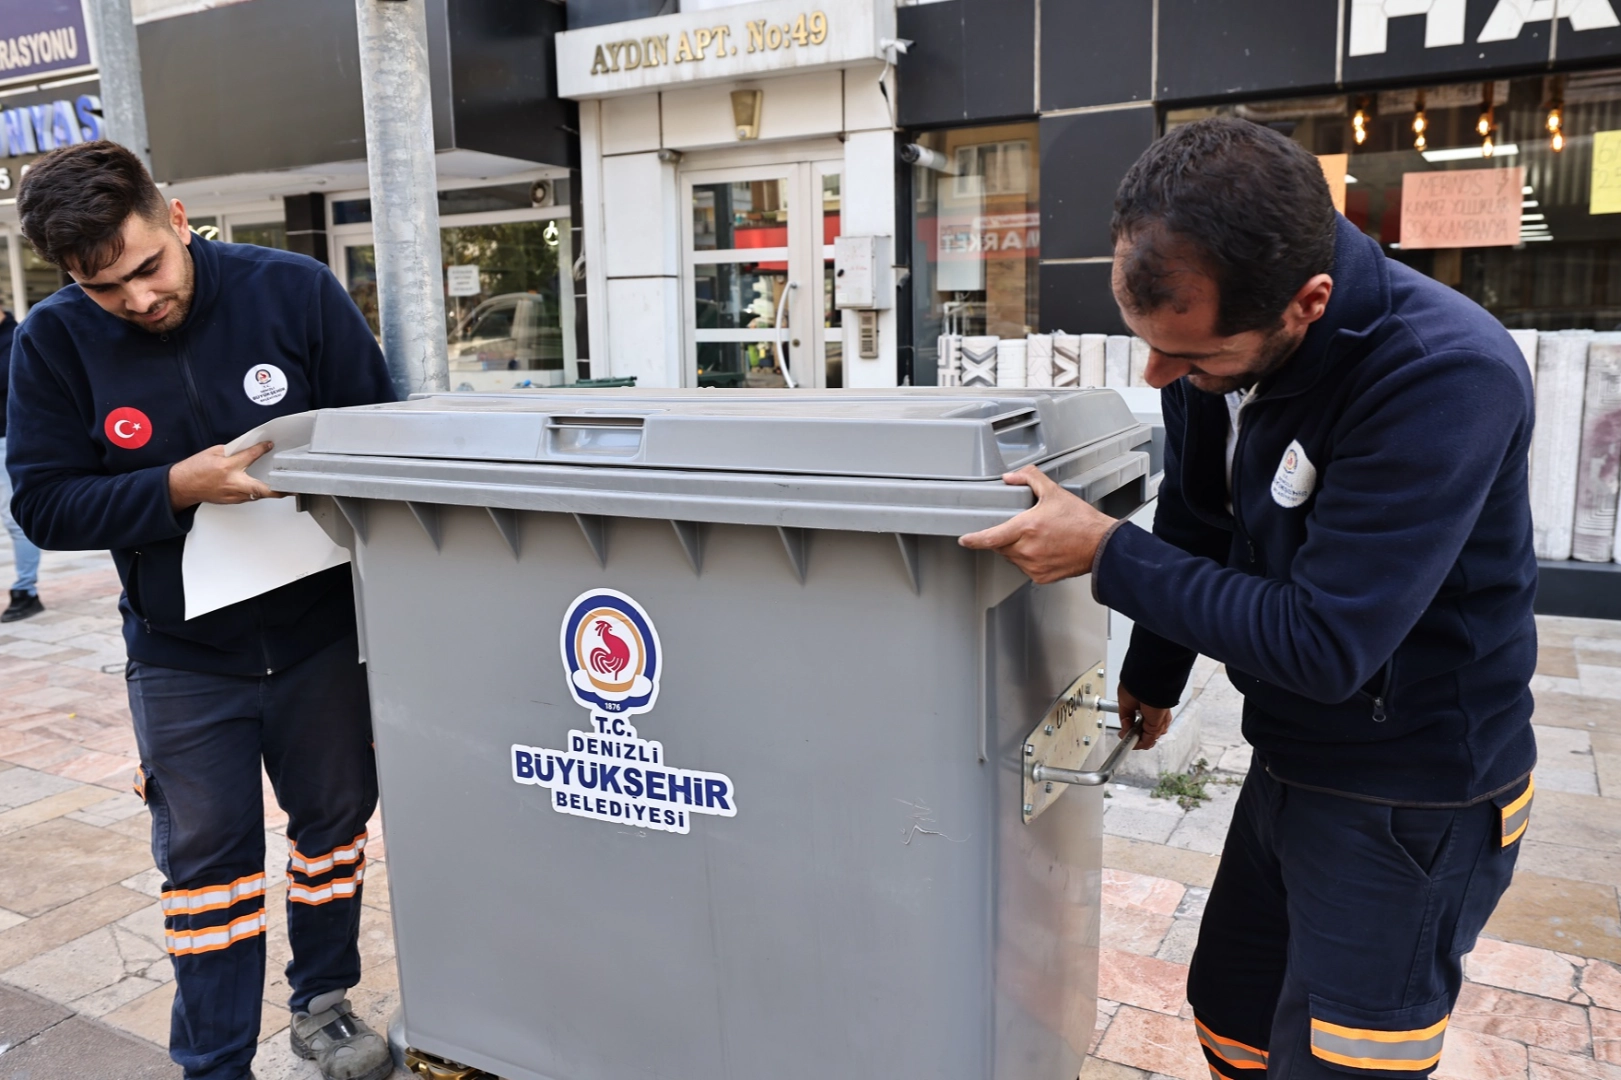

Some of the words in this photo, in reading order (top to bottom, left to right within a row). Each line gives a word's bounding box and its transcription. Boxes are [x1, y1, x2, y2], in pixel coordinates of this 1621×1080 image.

[590, 34, 669, 75] AYDIN
[674, 25, 737, 63] APT.
[747, 10, 828, 53] No:49
[604, 702, 621, 711] 1876
[595, 716, 632, 737] T.C.
[572, 736, 658, 763] DENİZLİ
[515, 750, 731, 811] BÜYÜKŞEHİR
[556, 791, 685, 827] BELEDİYESİ
